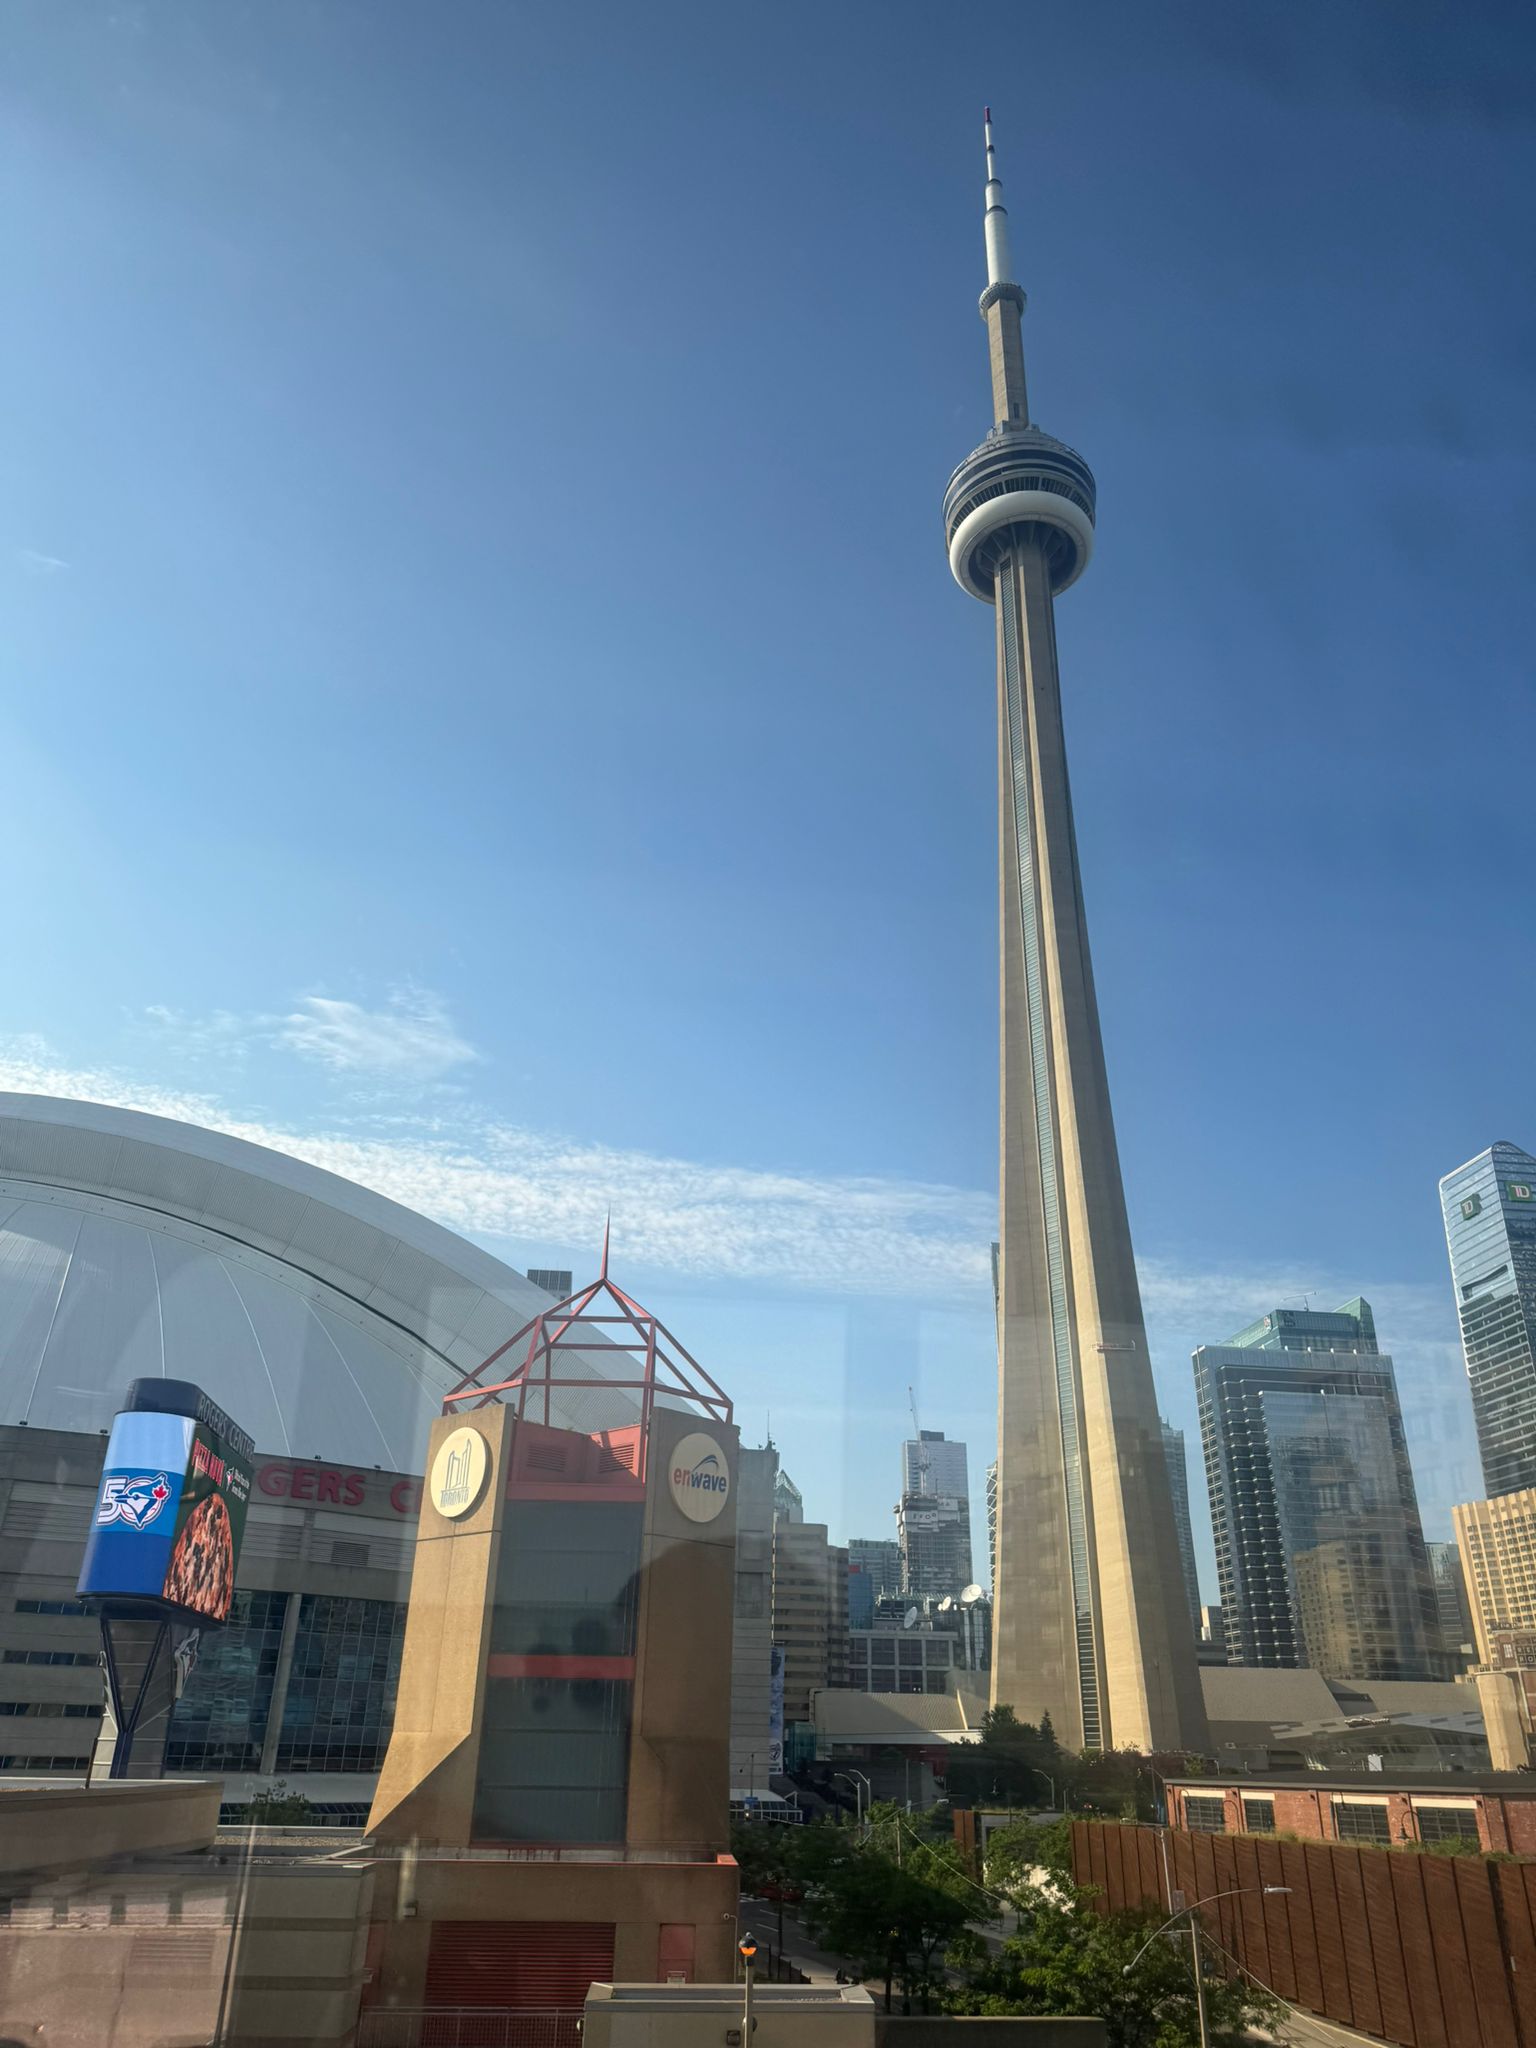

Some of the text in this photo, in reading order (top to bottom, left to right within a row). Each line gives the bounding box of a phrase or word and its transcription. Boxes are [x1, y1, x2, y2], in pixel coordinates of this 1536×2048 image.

[1511, 1184, 1530, 1198] TD
[1461, 1200, 1473, 1215] TD
[198, 1395, 255, 1463] ROGERS CENTRE
[673, 1467, 727, 1493] enwave
[440, 1488, 470, 1508] TORONTO
